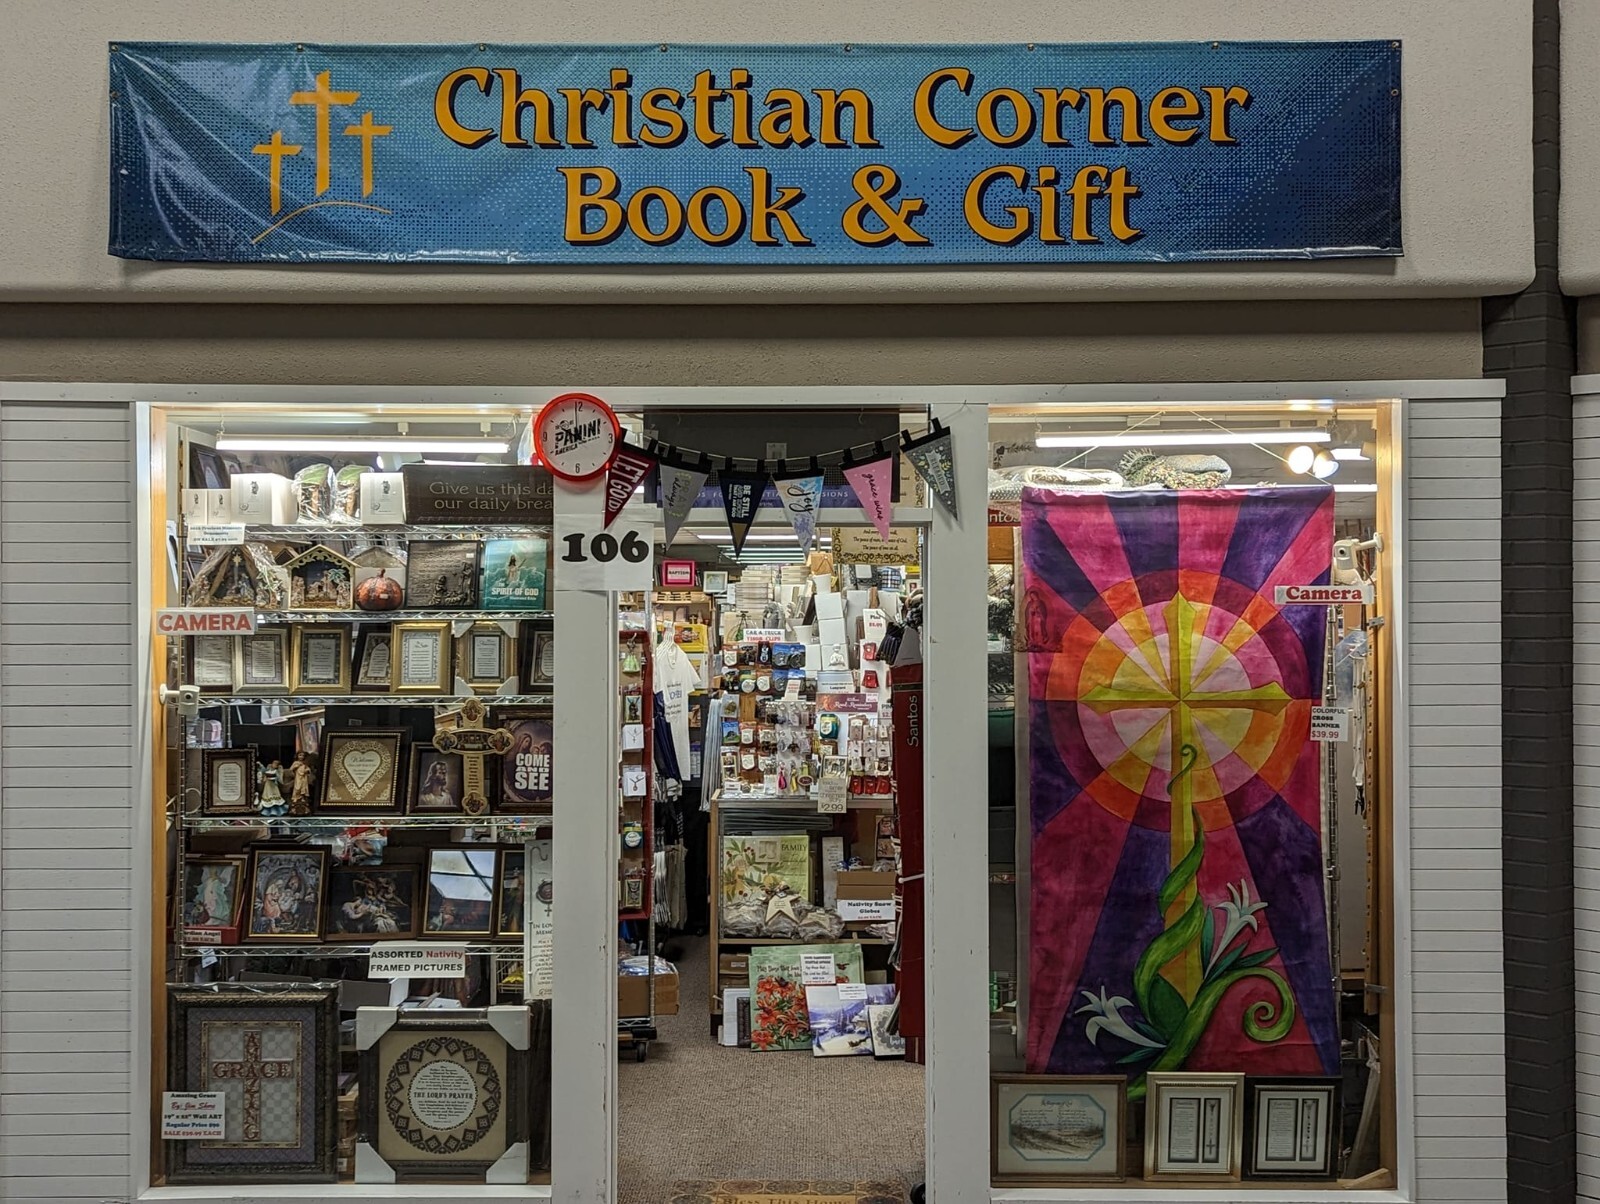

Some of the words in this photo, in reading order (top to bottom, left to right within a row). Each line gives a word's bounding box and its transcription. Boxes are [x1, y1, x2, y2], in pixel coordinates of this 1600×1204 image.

[434, 67, 882, 148] Christian
[914, 67, 1250, 148] Corner
[557, 166, 811, 247] Book
[841, 164, 931, 247] &
[963, 164, 1141, 246] Gift
[554, 418, 602, 449] PANINI
[575, 463, 580, 473] 6
[429, 482, 470, 495] Give
[476, 485, 495, 495] us
[501, 483, 531, 495] this
[536, 483, 553, 495] da
[743, 484, 752, 496] BE
[434, 500, 463, 509] our
[468, 498, 510, 512] daily
[516, 498, 553, 510] brea
[741, 497, 751, 518] STILL
[989, 511, 1021, 522] ntos
[562, 531, 649, 563] 106
[525, 588, 539, 596] GOD
[1286, 586, 1362, 600] Camera
[158, 614, 253, 631] CAMERA
[907, 695, 919, 747] Santos
[515, 753, 550, 767] COME
[514, 772, 549, 790] SEE
[821, 803, 844, 812] $2.99
[371, 951, 423, 959] ASSORTED
[426, 950, 464, 960] Nativity
[213, 1062, 293, 1078] GRACE
